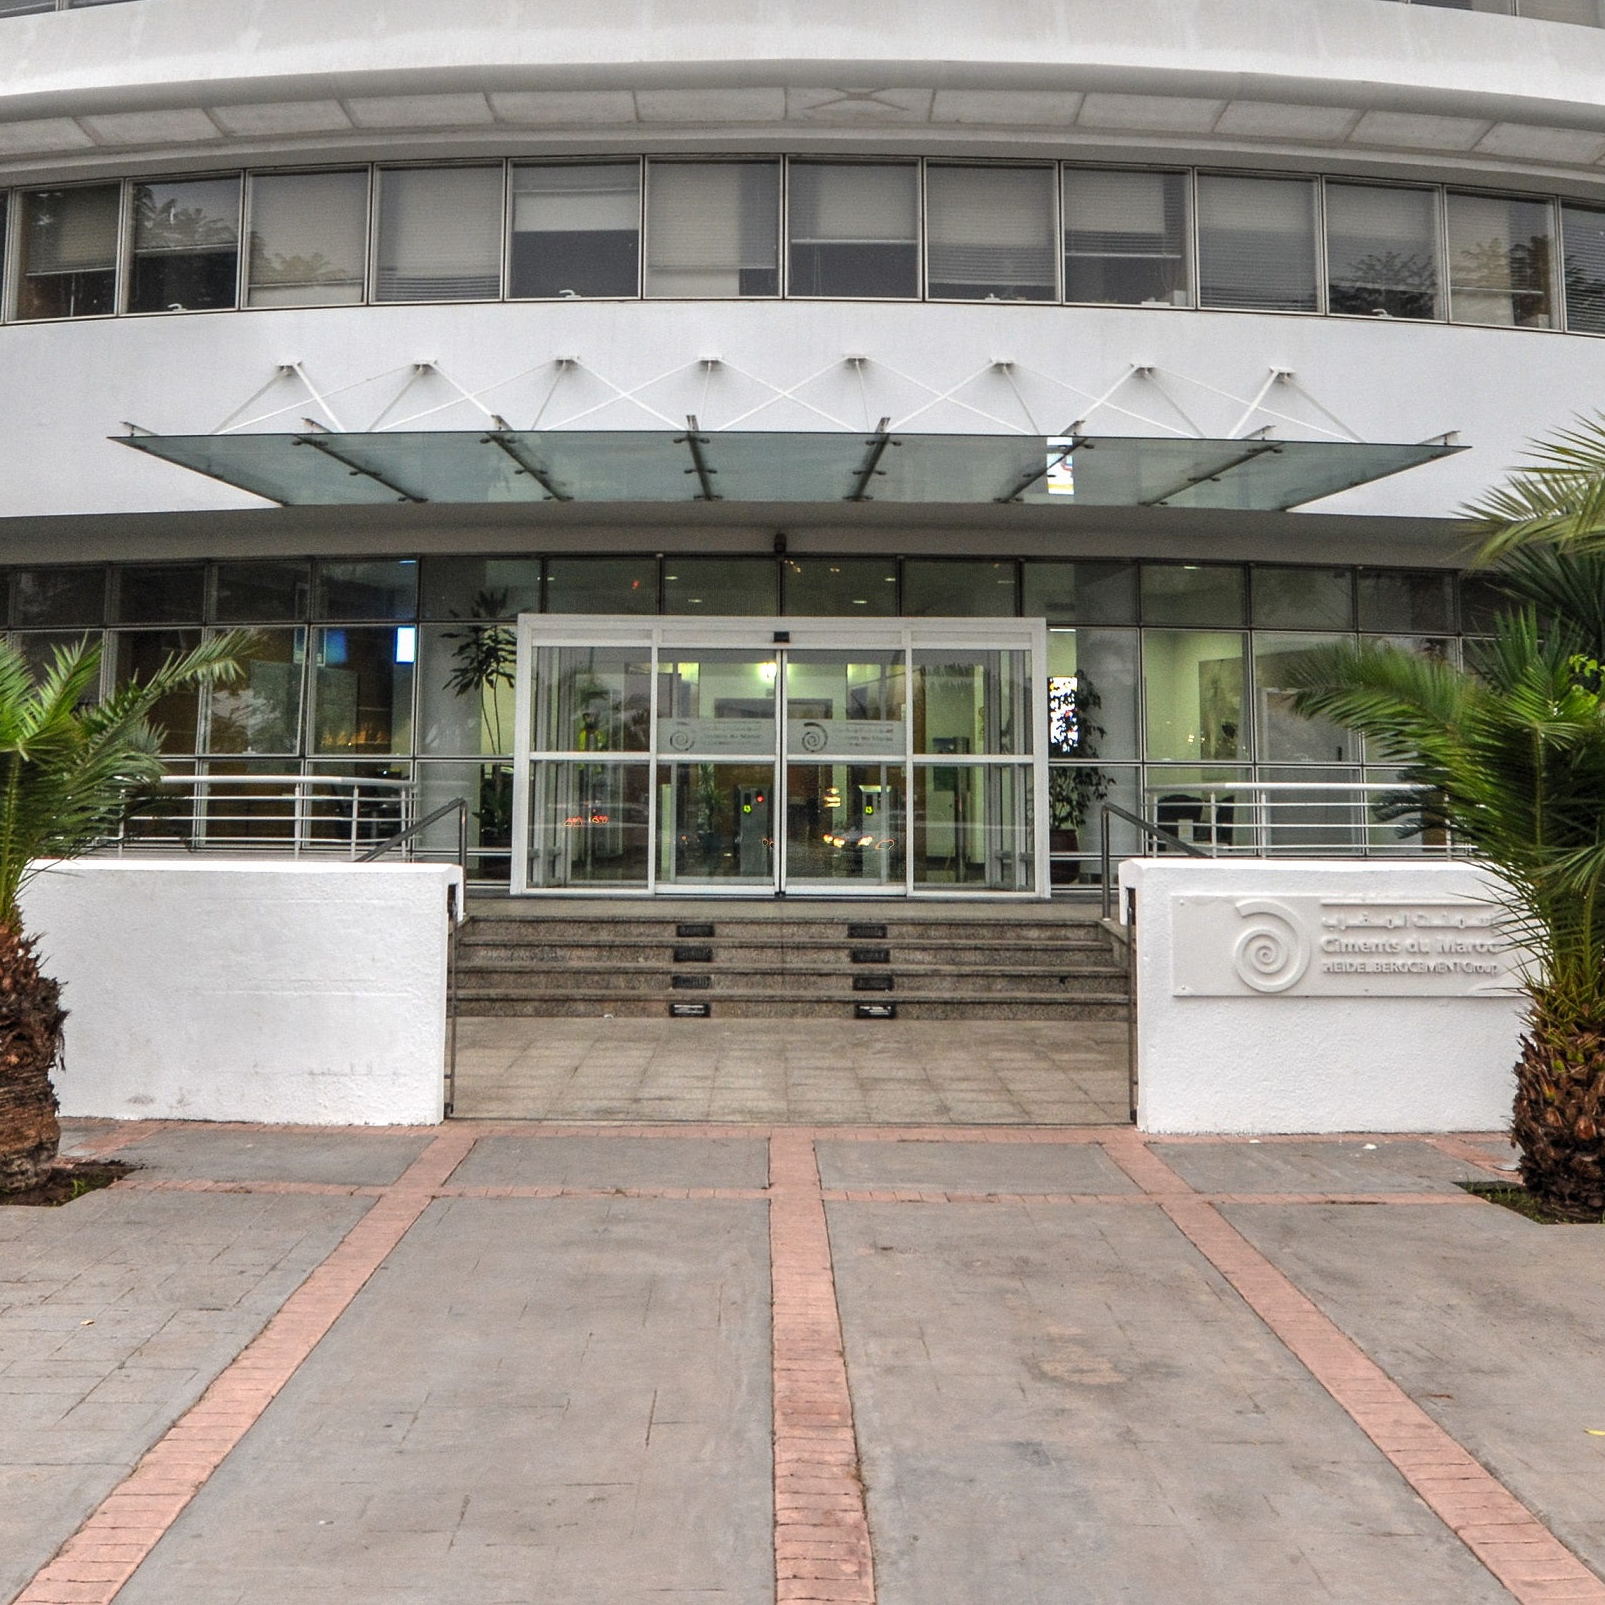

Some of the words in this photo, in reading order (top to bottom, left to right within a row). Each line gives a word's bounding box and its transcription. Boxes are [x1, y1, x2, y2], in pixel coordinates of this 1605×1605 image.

[1322, 937, 1400, 954] Ciments
[1408, 936, 1430, 954] du
[1437, 937, 1497, 954] Maroc
[1323, 962, 1461, 974] HEIDELBERGCEMENT
[1462, 962, 1499, 977] Group
